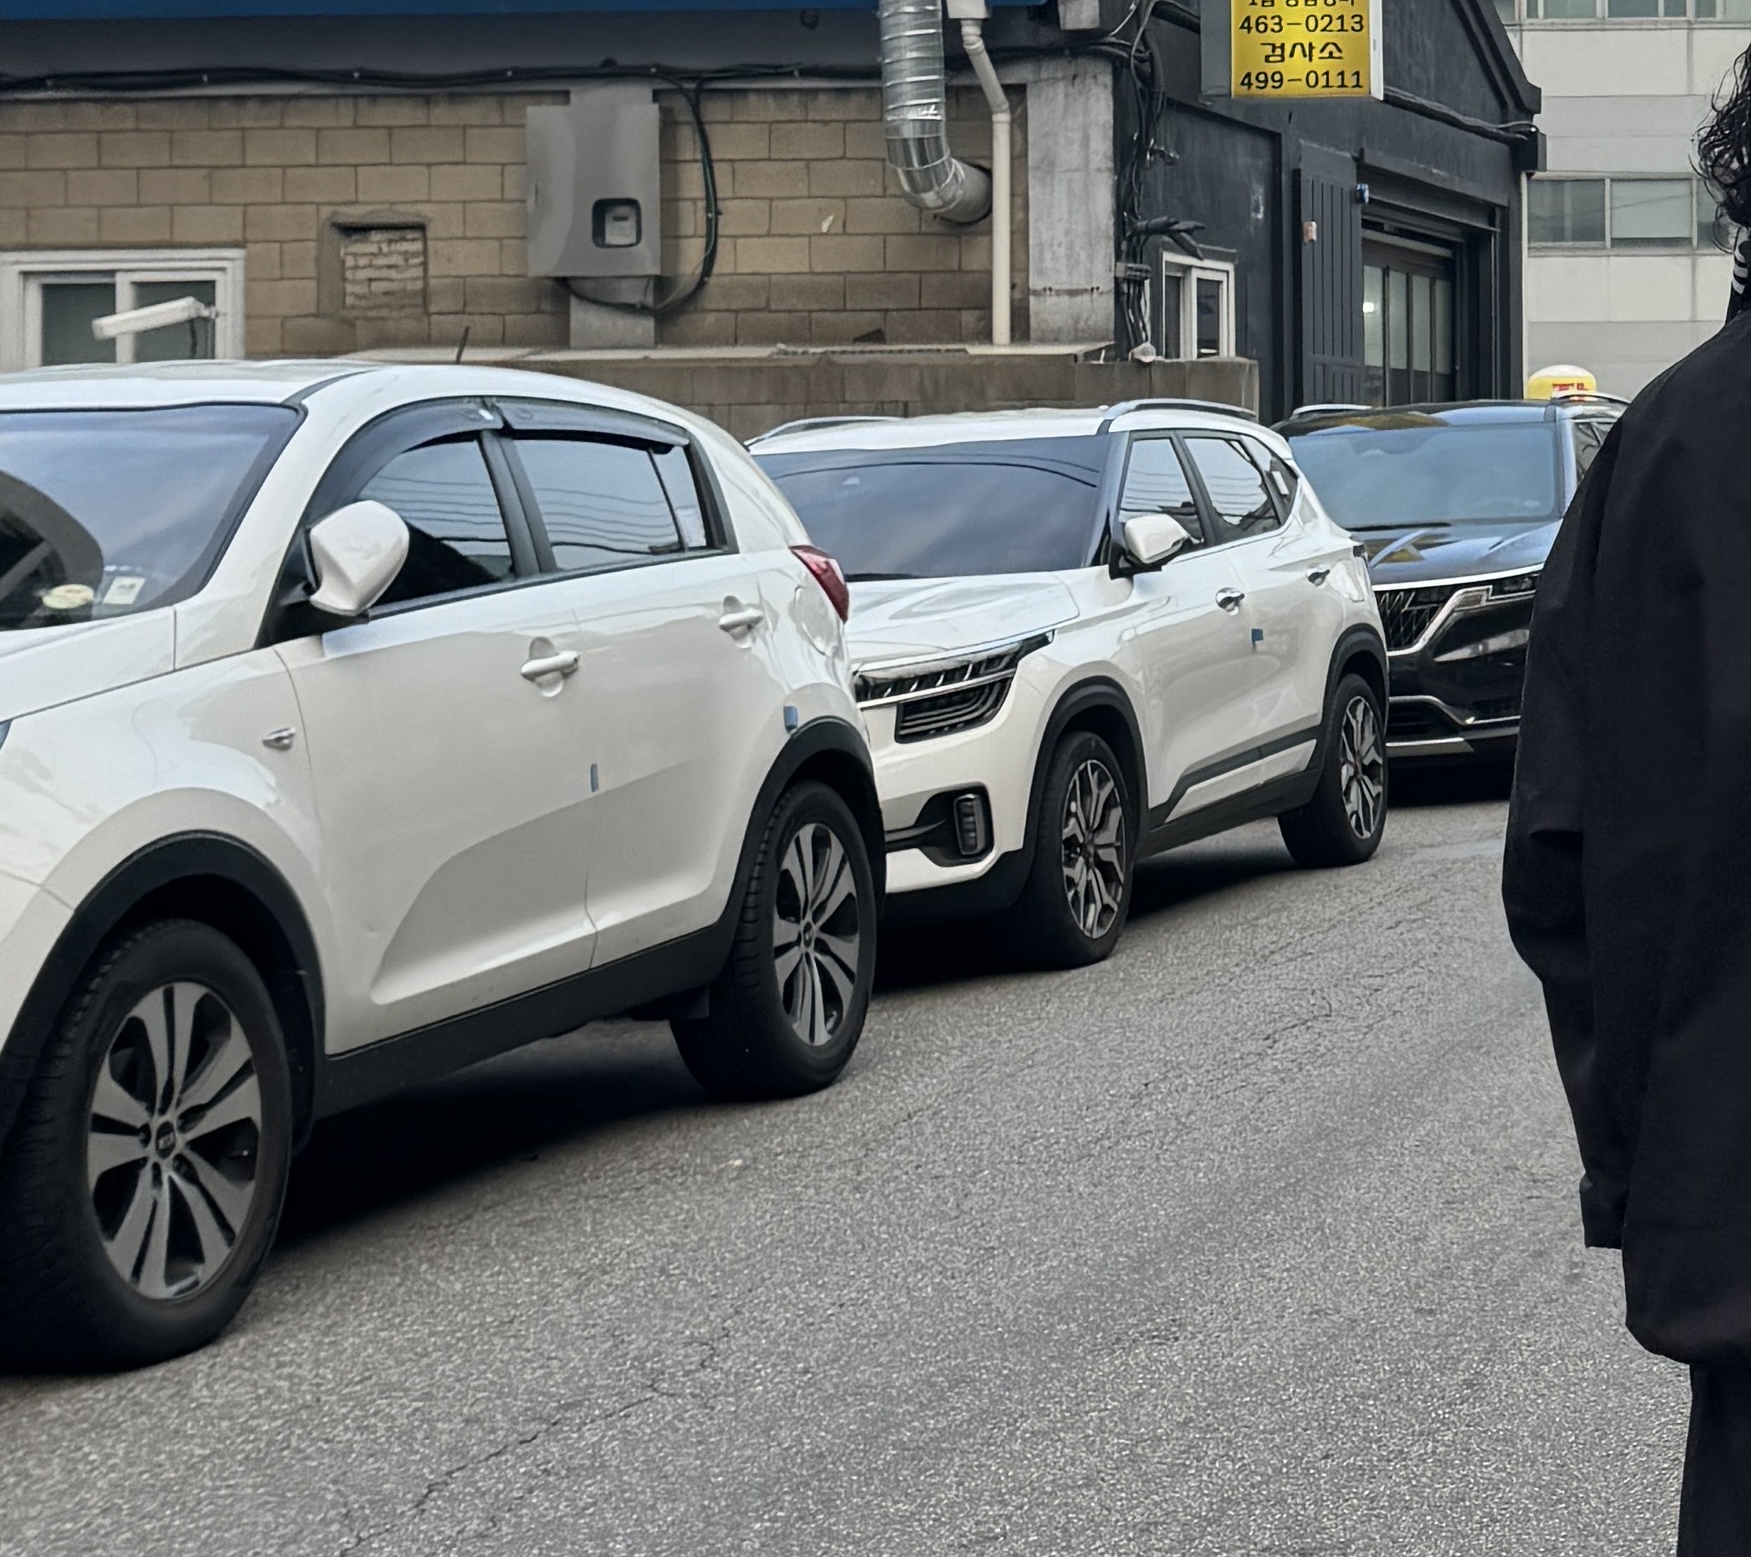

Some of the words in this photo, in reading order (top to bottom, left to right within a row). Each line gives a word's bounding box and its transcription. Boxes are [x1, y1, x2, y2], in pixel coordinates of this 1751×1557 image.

[1239, 13, 1364, 34] 463-0213
[1260, 41, 1344, 64] 검사소
[1239, 69, 1364, 91] 499-0111
